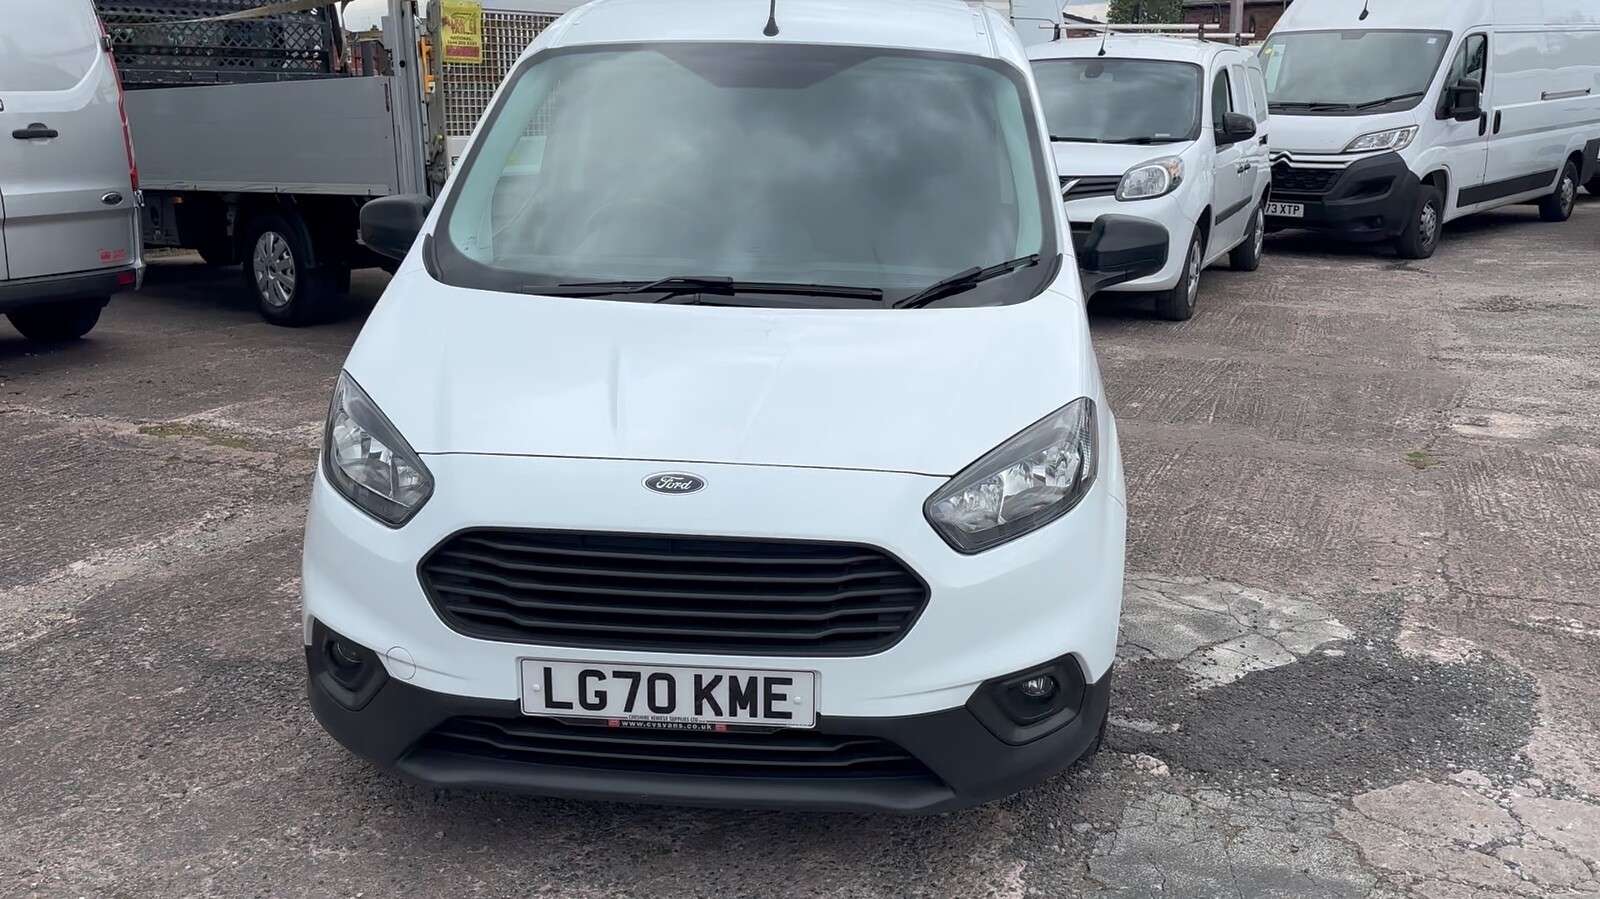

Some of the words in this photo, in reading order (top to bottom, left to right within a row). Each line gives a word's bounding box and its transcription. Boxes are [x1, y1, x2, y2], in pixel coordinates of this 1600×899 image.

[1280, 204, 1300, 215] XTP
[656, 475, 693, 490] Ford
[543, 666, 677, 714] LG70
[693, 673, 793, 720] KME
[622, 721, 712, 730] www.cvsvans.co.uk
